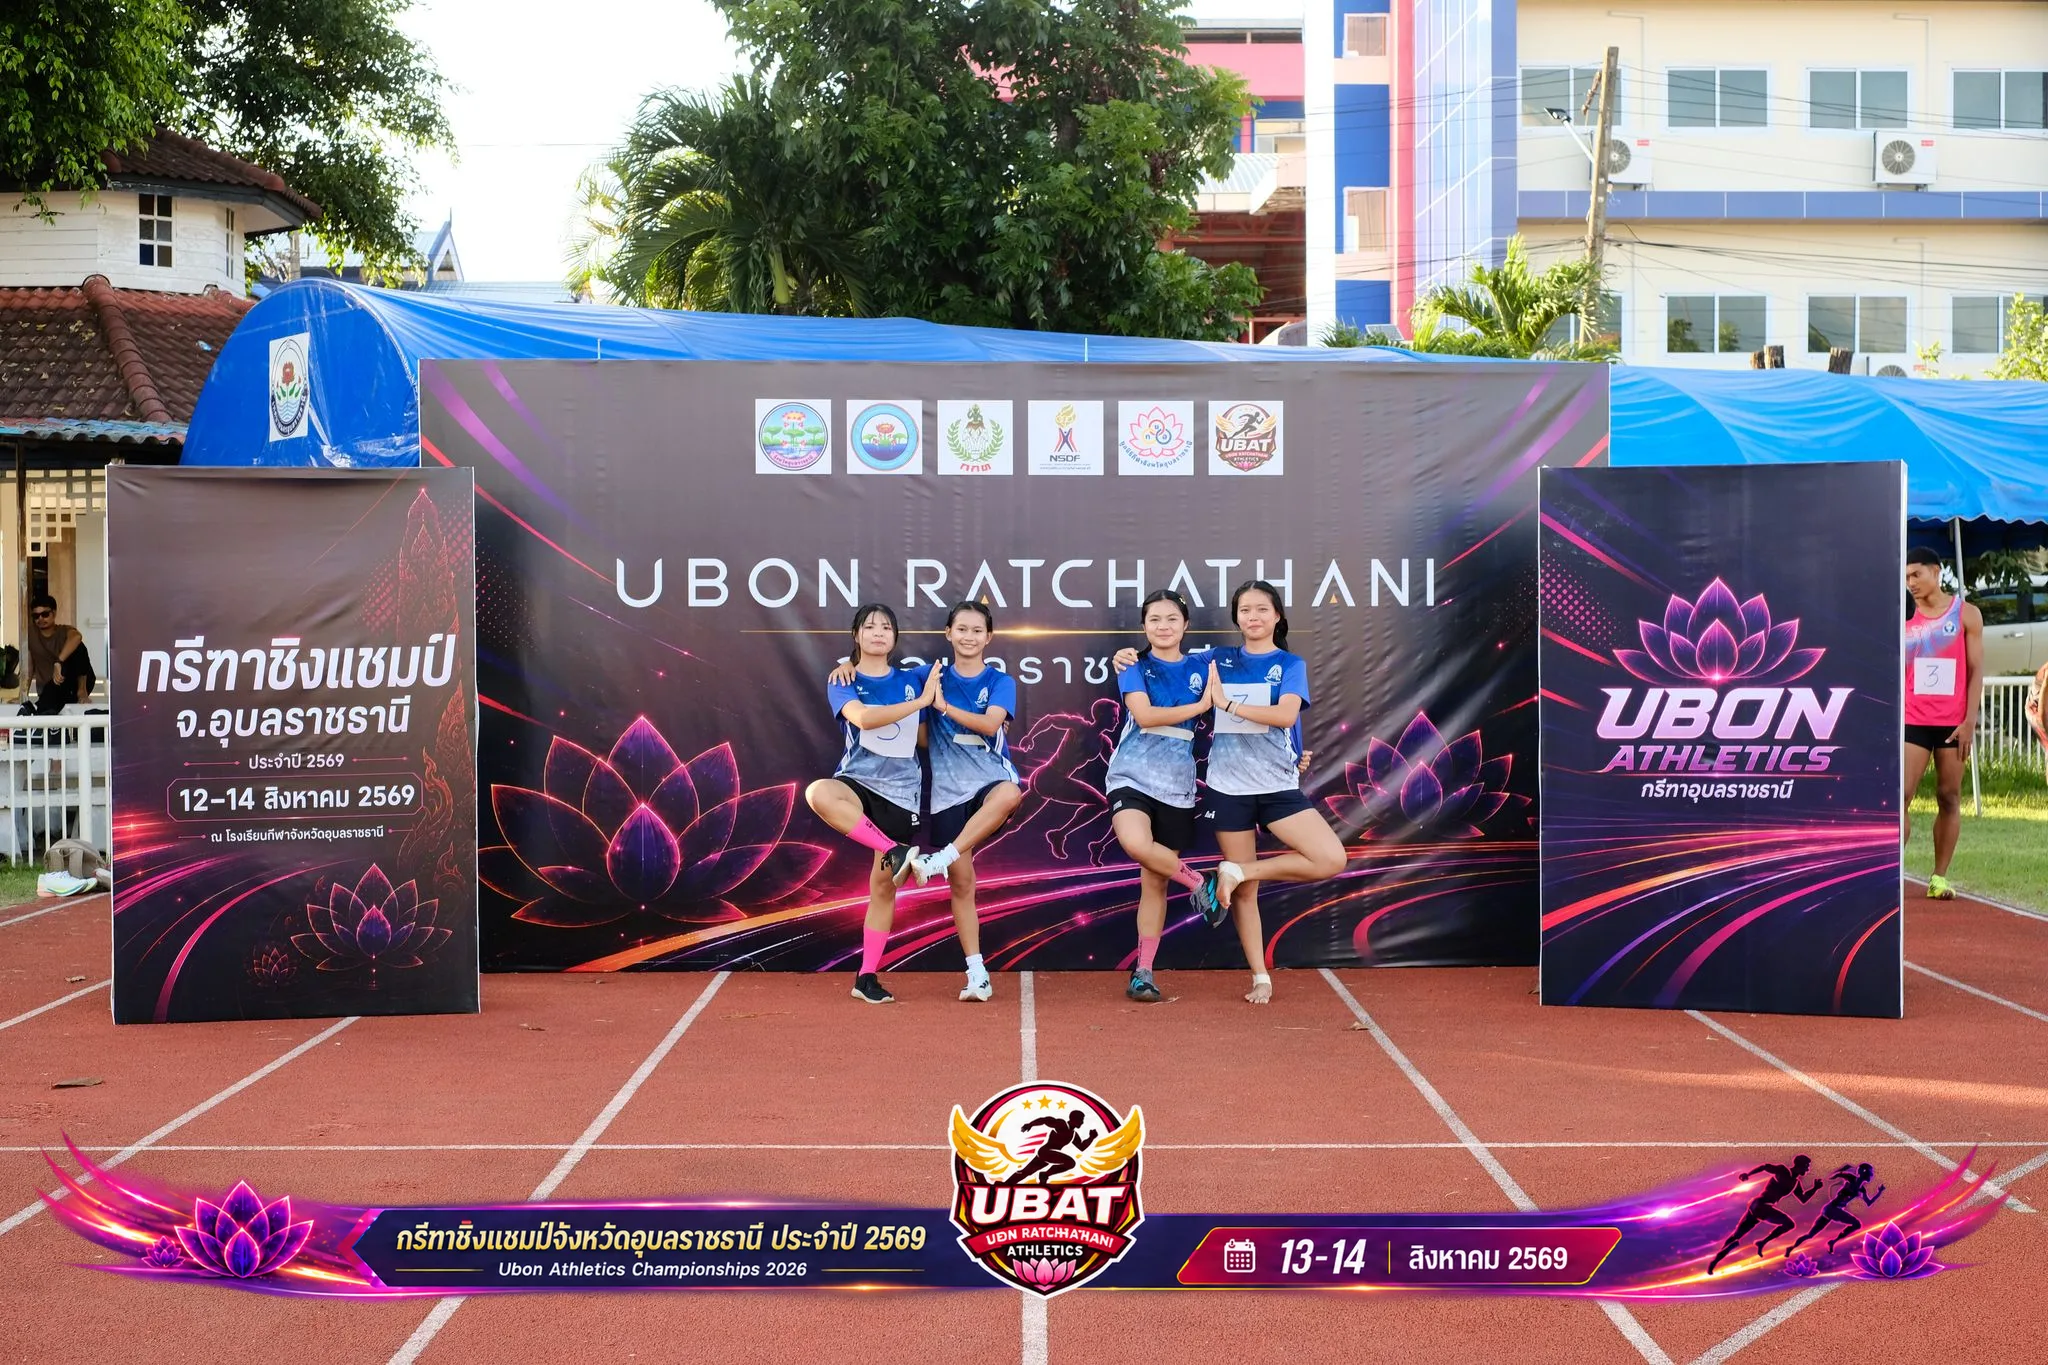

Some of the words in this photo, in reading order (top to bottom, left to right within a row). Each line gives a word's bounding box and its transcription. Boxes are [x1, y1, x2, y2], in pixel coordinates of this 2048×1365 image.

[1220, 439, 1273, 452] UBAT
[960, 463, 992, 472] กกท
[1049, 454, 1081, 463] NSDF
[616, 557, 859, 608] UBON
[907, 557, 1435, 608] RATCHATHANI
[137, 633, 456, 692] กรีฑาชิงแชมป์
[1923, 664, 1939, 688] 3
[176, 695, 412, 748] จ.อุบลราชธานี
[1596, 687, 1856, 740] UBON
[249, 754, 301, 769] ประจำปี
[306, 753, 345, 769] 2569
[1603, 745, 1843, 772] ATHLETICS
[264, 786, 350, 811] สิงหาคม
[358, 784, 416, 808] 2569
[1640, 779, 1795, 803] กรีฑาอุบลราชธานี
[211, 832, 223, 843] ณ
[226, 824, 385, 844] โรงเรียนกีฬาจังหวัดอุบลราชธานี
